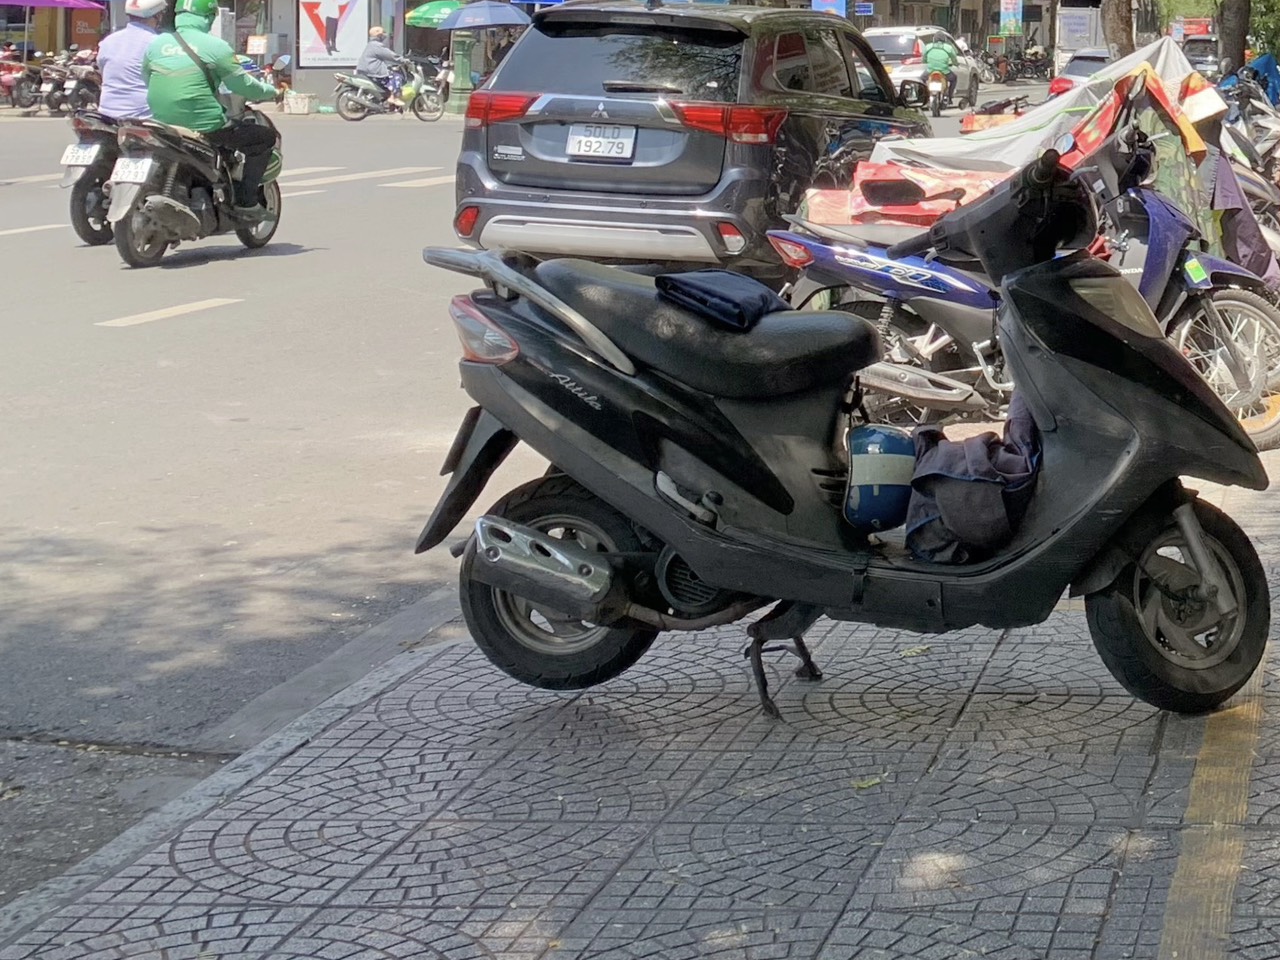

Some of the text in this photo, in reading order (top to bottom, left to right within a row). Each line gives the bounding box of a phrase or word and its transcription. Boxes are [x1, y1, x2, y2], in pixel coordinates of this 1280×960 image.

[583, 125, 621, 139] 50LD
[576, 140, 625, 155] 192.79
[549, 373, 602, 411] Attila
